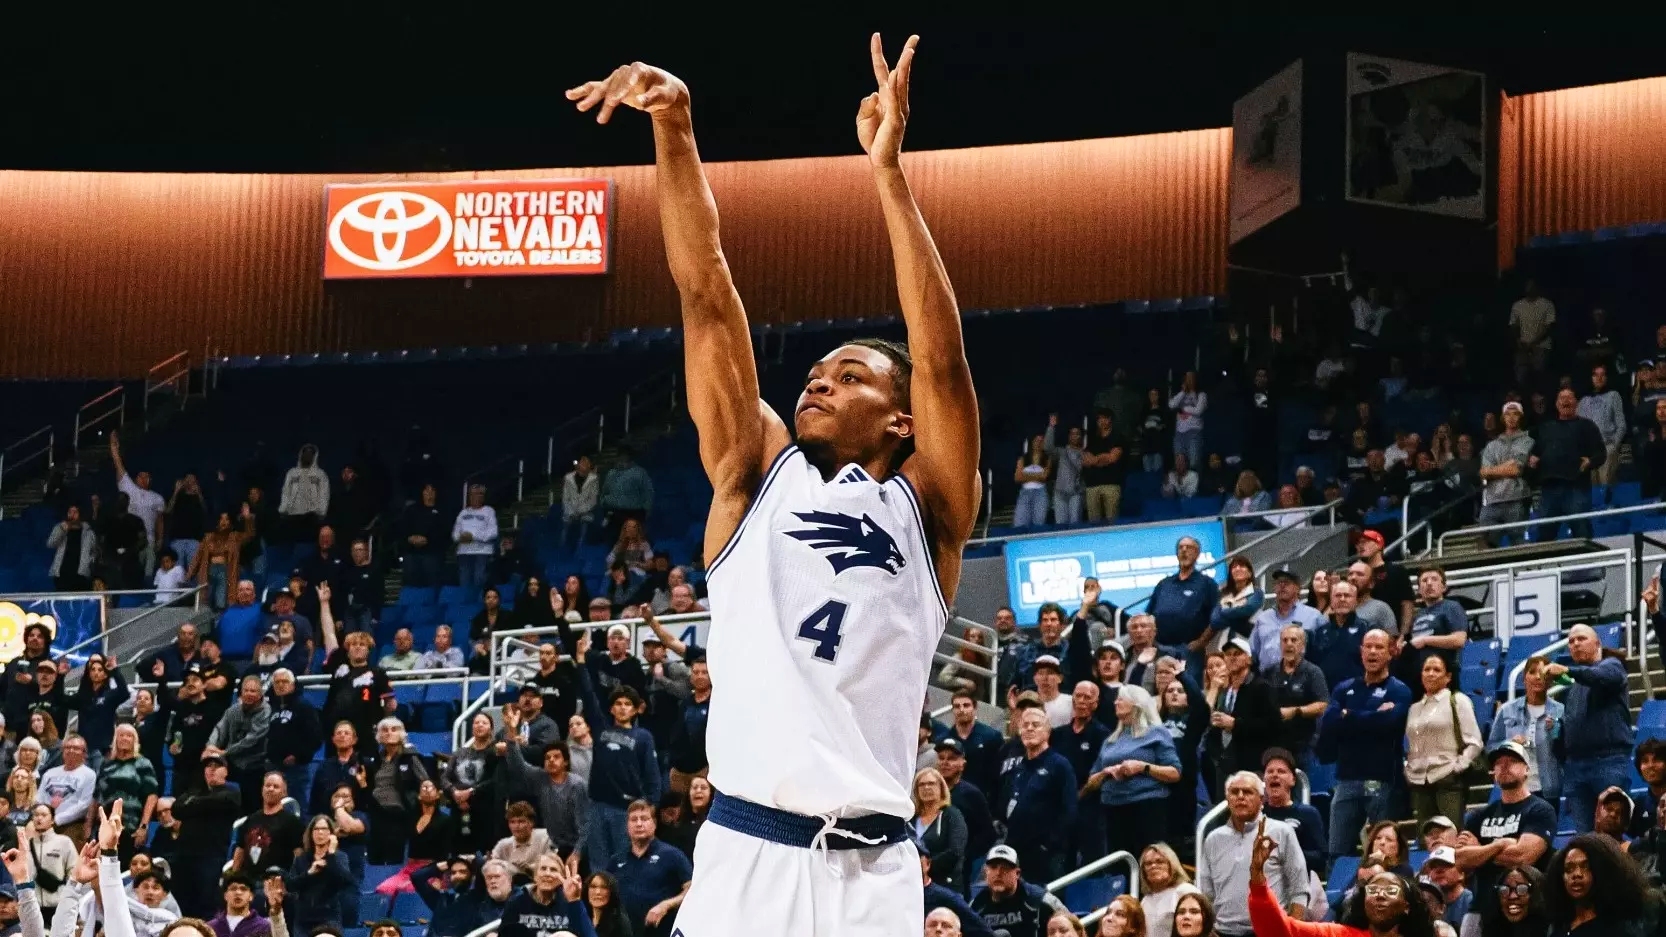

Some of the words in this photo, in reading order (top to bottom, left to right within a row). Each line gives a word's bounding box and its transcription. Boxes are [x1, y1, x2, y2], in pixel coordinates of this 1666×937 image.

[455, 190, 604, 217] NORTHERN
[453, 215, 602, 250] NEVADA
[454, 250, 525, 267] TOYOTA
[529, 249, 602, 265] DEALERS
[1513, 594, 1540, 630] 5
[795, 598, 850, 665] 4
